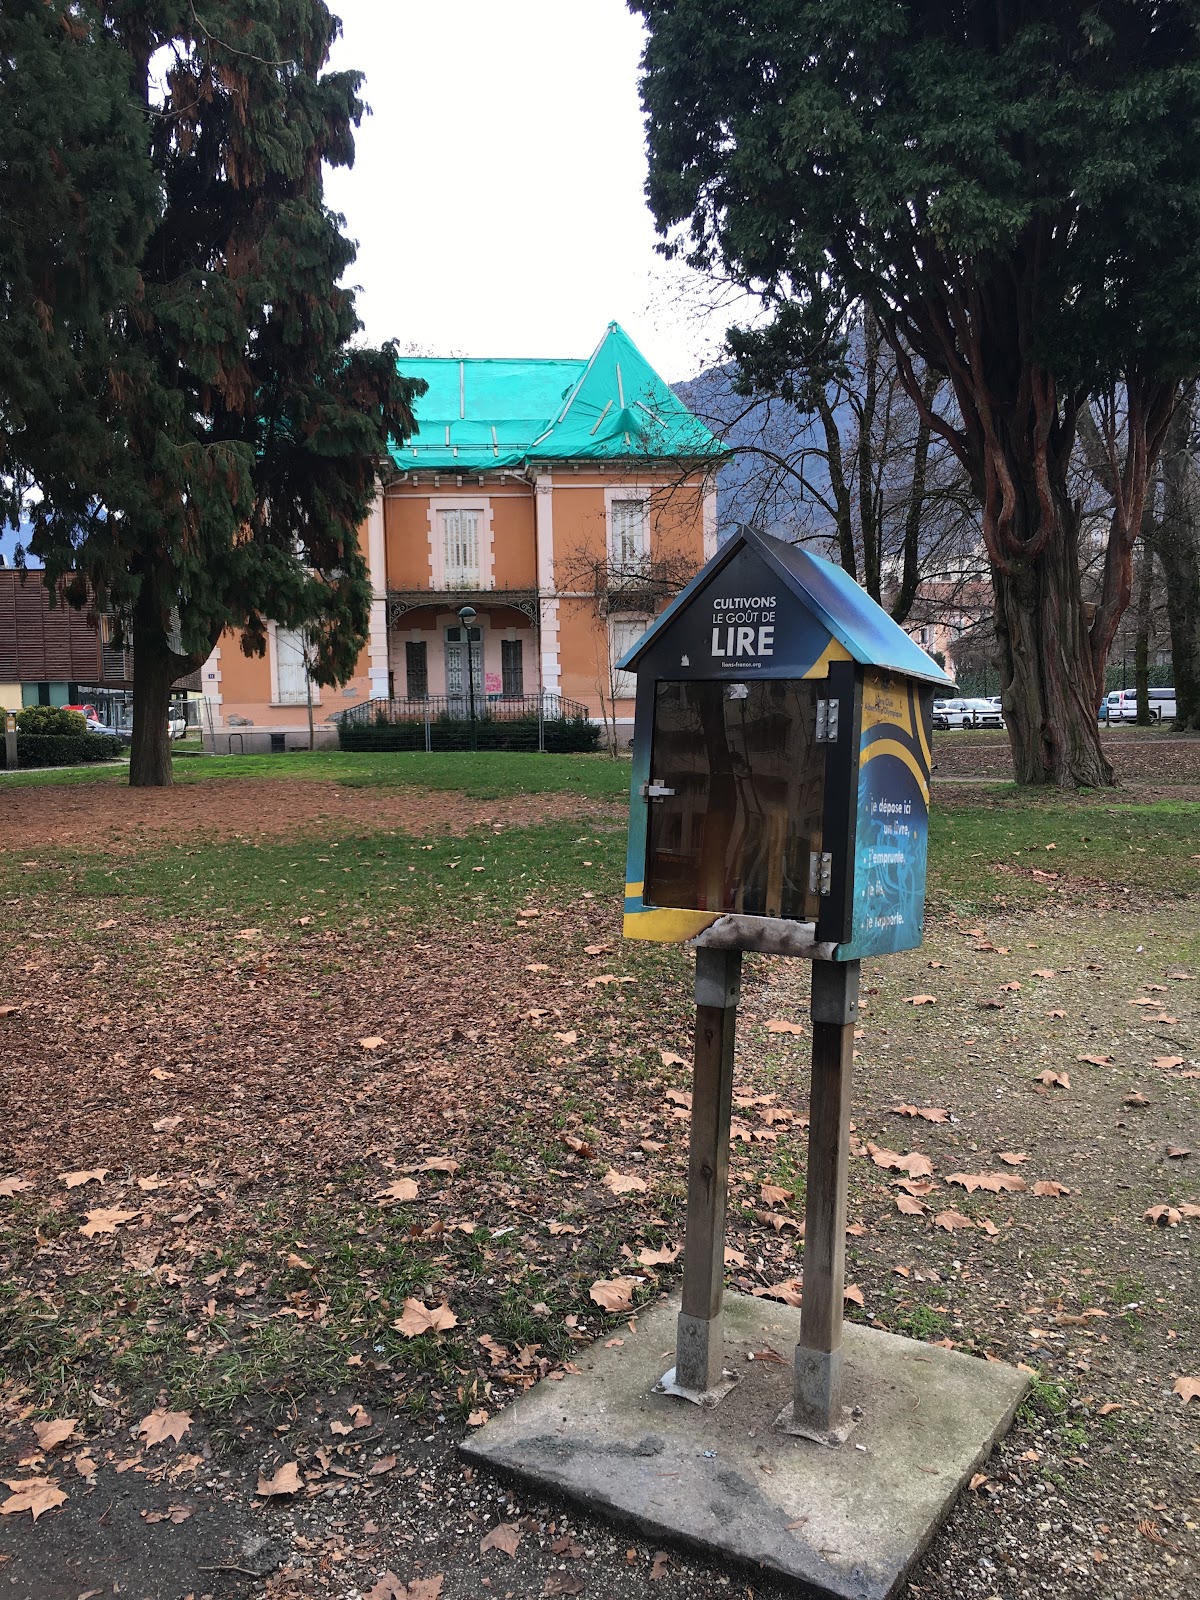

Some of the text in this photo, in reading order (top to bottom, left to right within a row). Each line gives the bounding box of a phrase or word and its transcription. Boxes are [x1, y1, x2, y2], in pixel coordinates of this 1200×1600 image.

[713, 596, 777, 609] CULTIVONS
[712, 610, 775, 624] LE GOÛT DE
[711, 626, 775, 657] LIRE
[879, 798, 902, 817] dépose
[903, 800, 911, 815] ici
